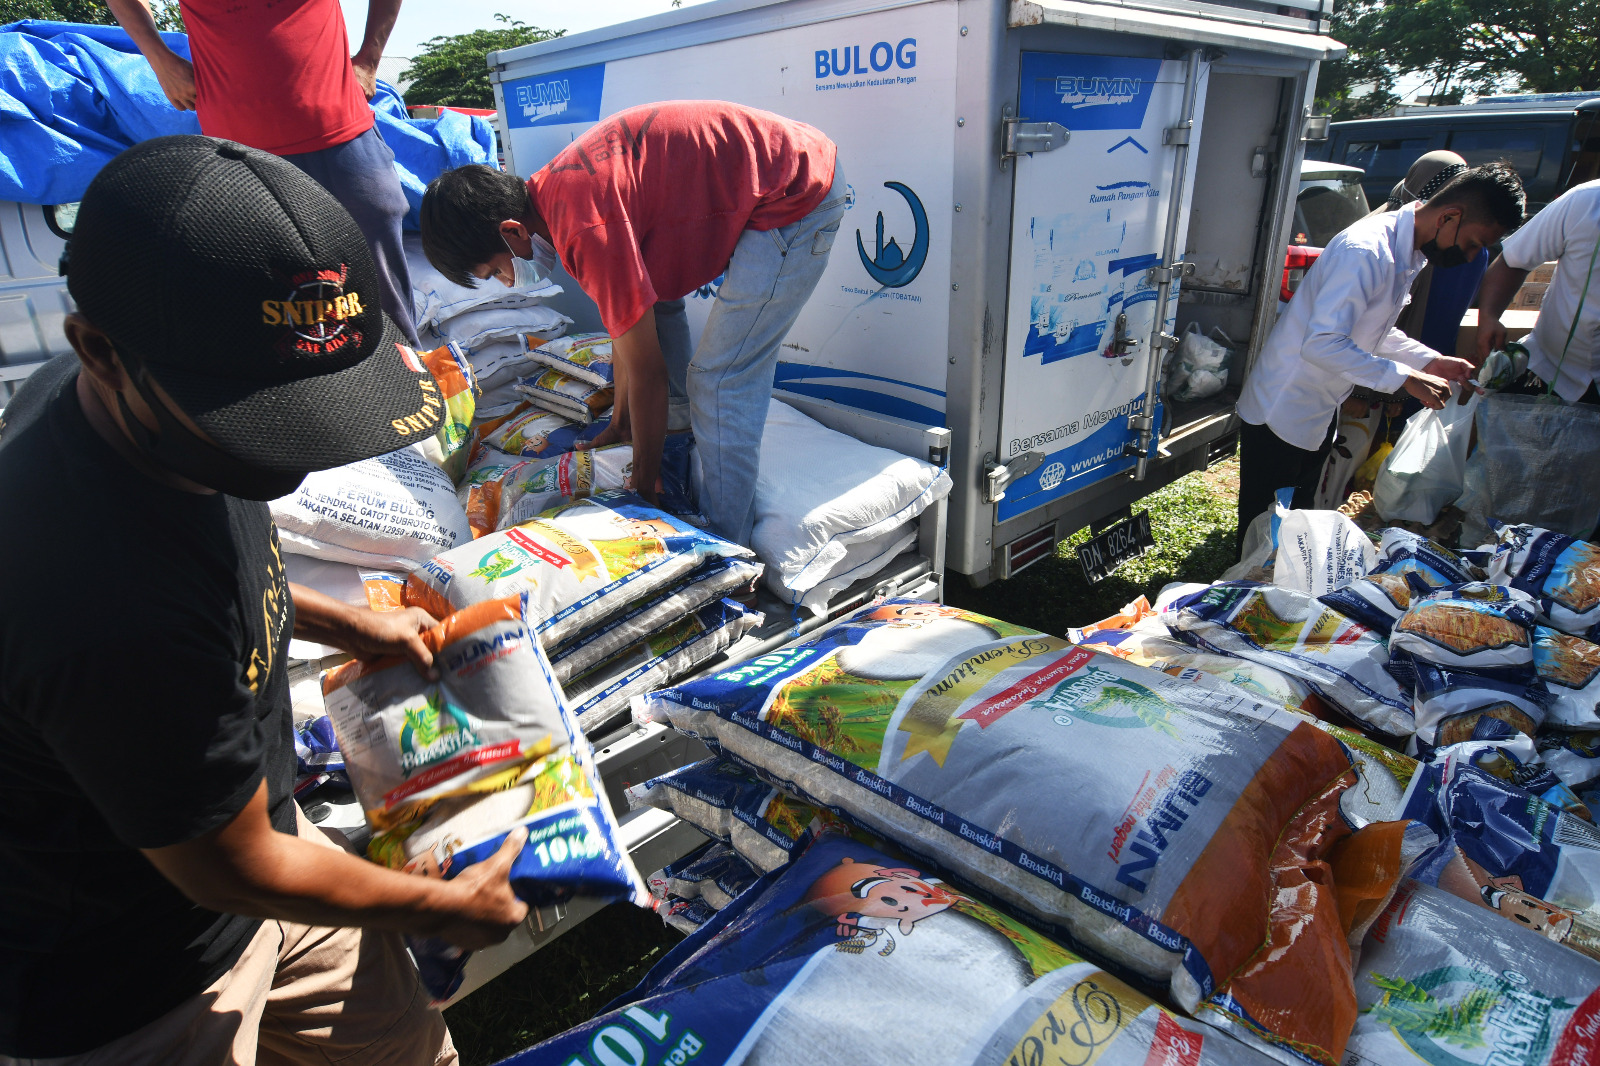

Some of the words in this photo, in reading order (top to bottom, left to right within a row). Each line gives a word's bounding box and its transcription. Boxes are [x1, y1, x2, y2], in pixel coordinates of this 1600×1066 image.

[815, 38, 917, 79] BULOG
[516, 79, 571, 107] BUMN
[896, 76, 917, 85] Pangan
[1055, 76, 1141, 94] BUMN
[1089, 193, 1116, 203] Rumah
[1117, 191, 1144, 202] Pangan
[1145, 188, 1160, 197] Kita
[261, 291, 365, 326] SNIPER
[391, 379, 442, 436] SNIPER
[1009, 420, 1080, 457] Bersama
[297, 498, 338, 519] JAKARTA
[339, 513, 381, 531] SELATAN
[382, 525, 404, 537] 12950
[411, 530, 453, 549] INDONESIA
[315, 493, 358, 513] JENDRAL
[360, 507, 389, 522] GATOT
[390, 511, 431, 531] SUBROTO
[448, 531, 457, 540] 49
[389, 502, 436, 521] BULOG
[1081, 543, 1103, 572] DN
[1107, 523, 1136, 557] 8264
[925, 638, 1051, 700] Premium
[980, 686, 1038, 717] Indonesia
[1107, 814, 1137, 865] negeri
[1115, 769, 1213, 894] BUMN
